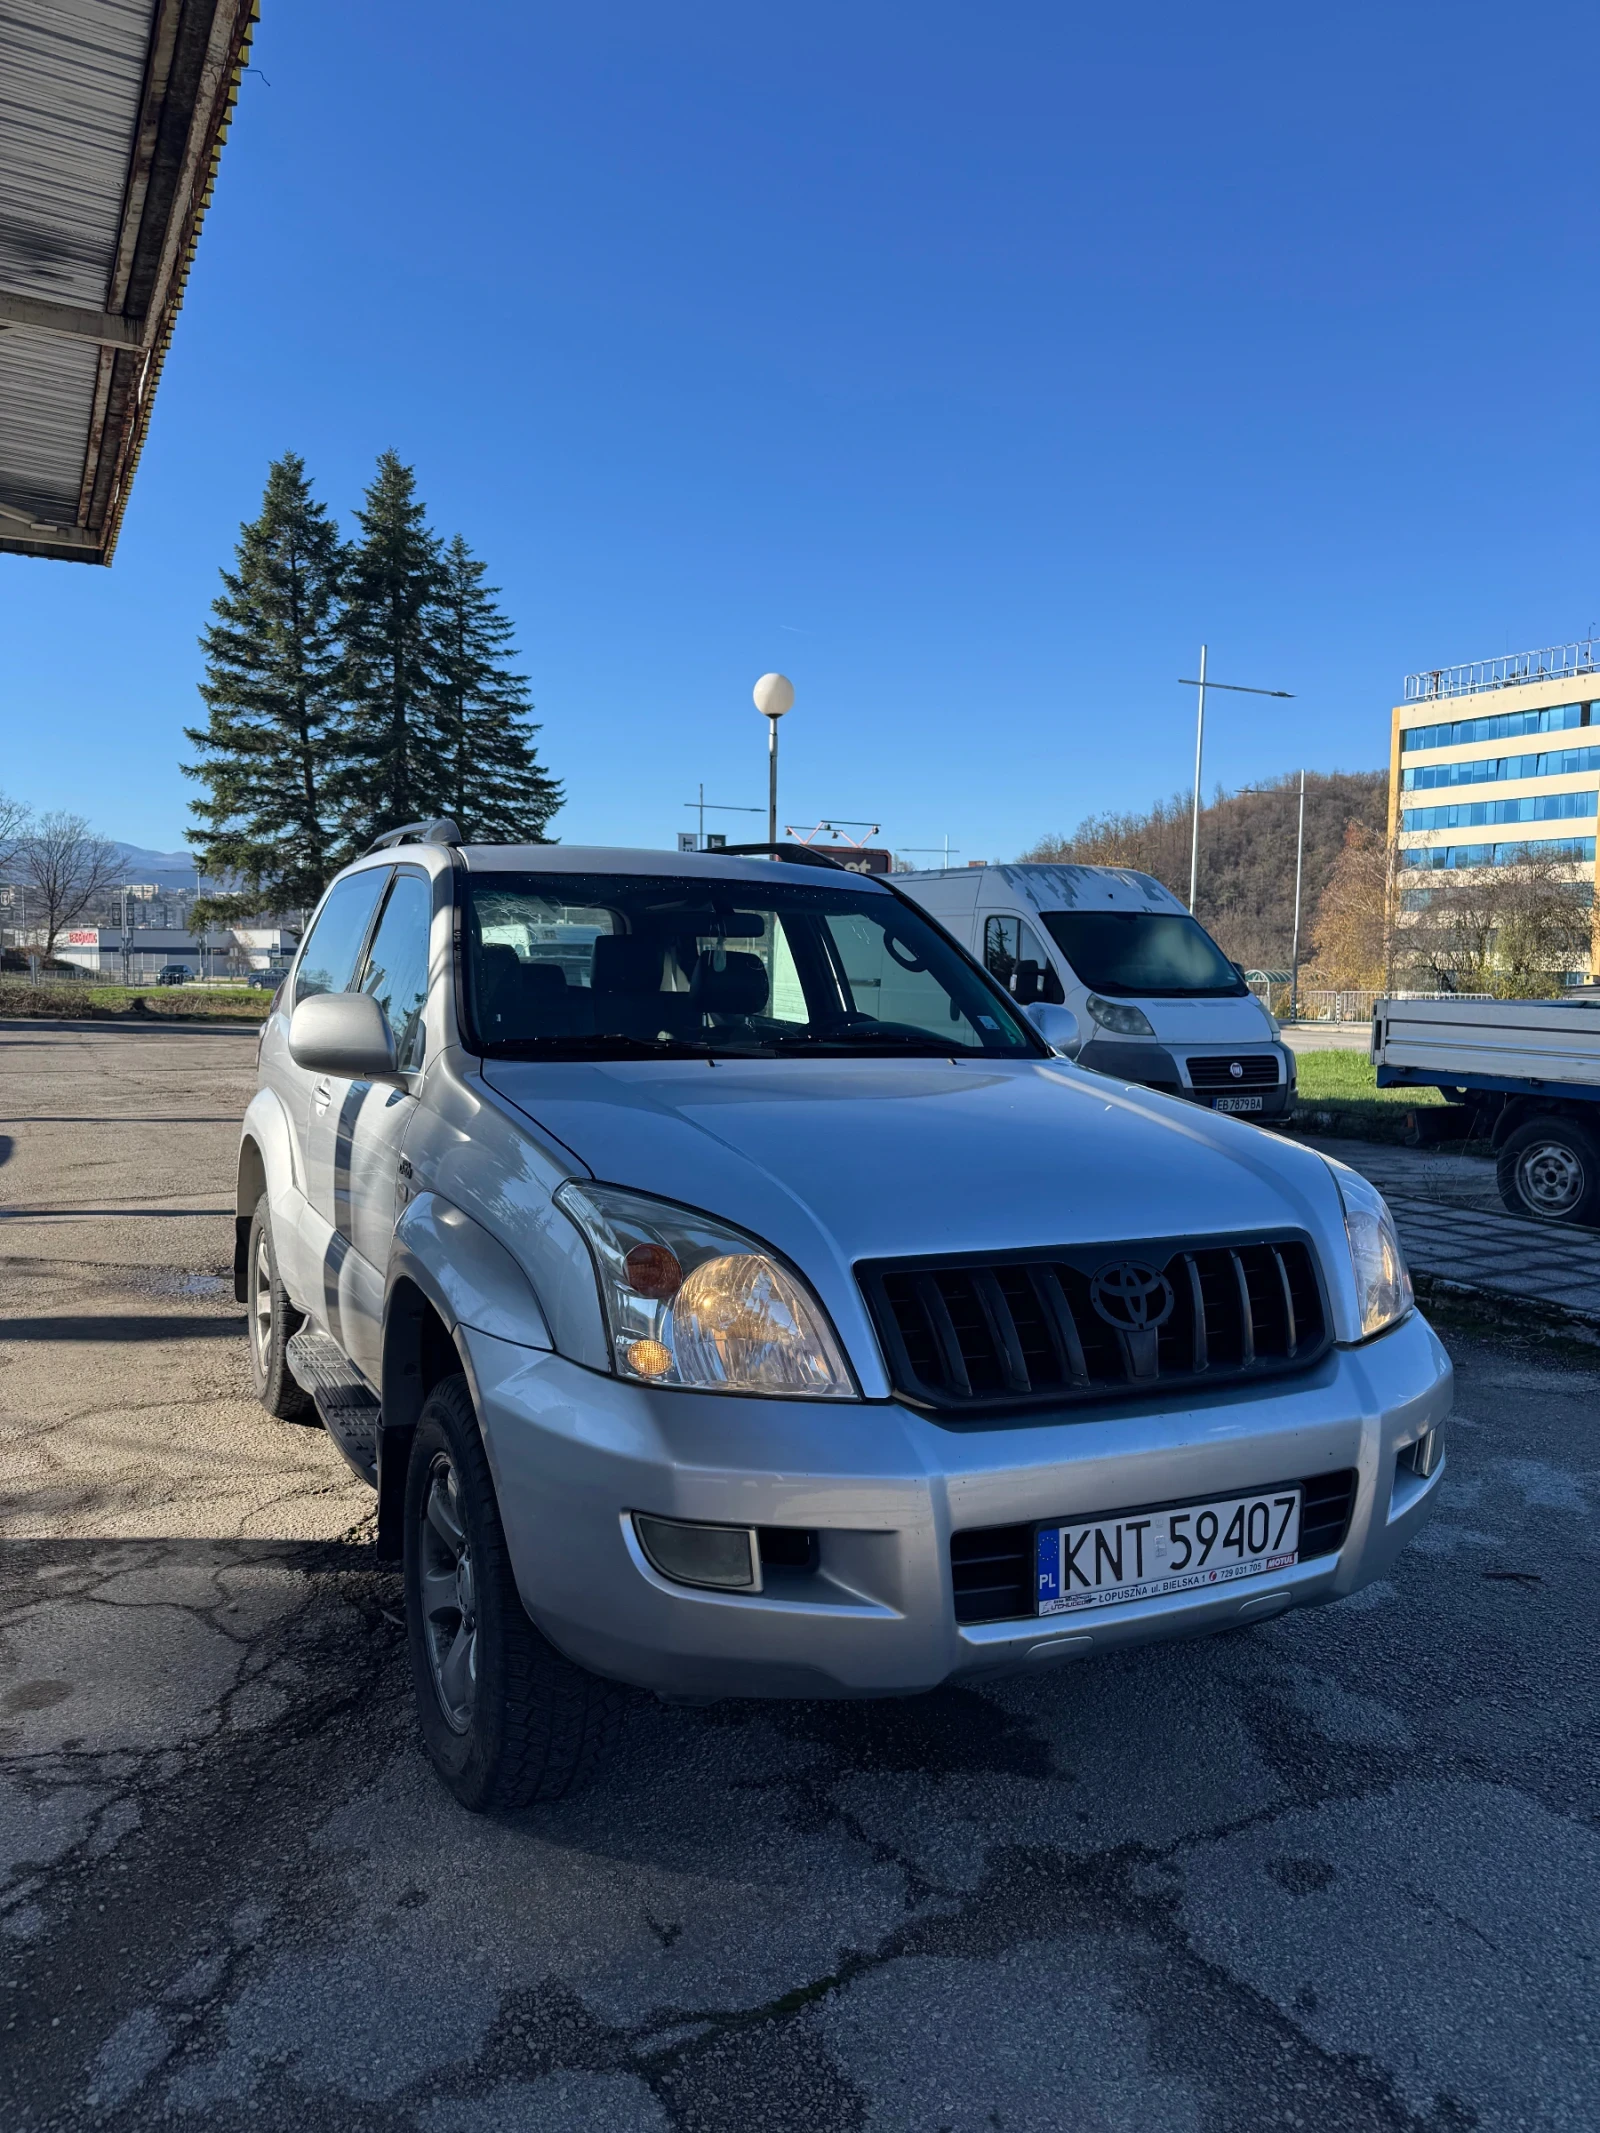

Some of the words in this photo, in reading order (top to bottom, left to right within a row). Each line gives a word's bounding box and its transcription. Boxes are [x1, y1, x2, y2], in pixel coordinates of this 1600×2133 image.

[1064, 1520, 1151, 1591] KNT
[1169, 1496, 1296, 1571] 59407
[1267, 1555, 1294, 1569] MOTUL
[1039, 1573, 1056, 1590] PL
[1098, 1586, 1148, 1603] ŁOPUSZNA
[1151, 1584, 1161, 1593] ul.
[1163, 1577, 1200, 1591] BIELSKA
[1220, 1568, 1233, 1579] 729
[1249, 1563, 1262, 1573] 705
